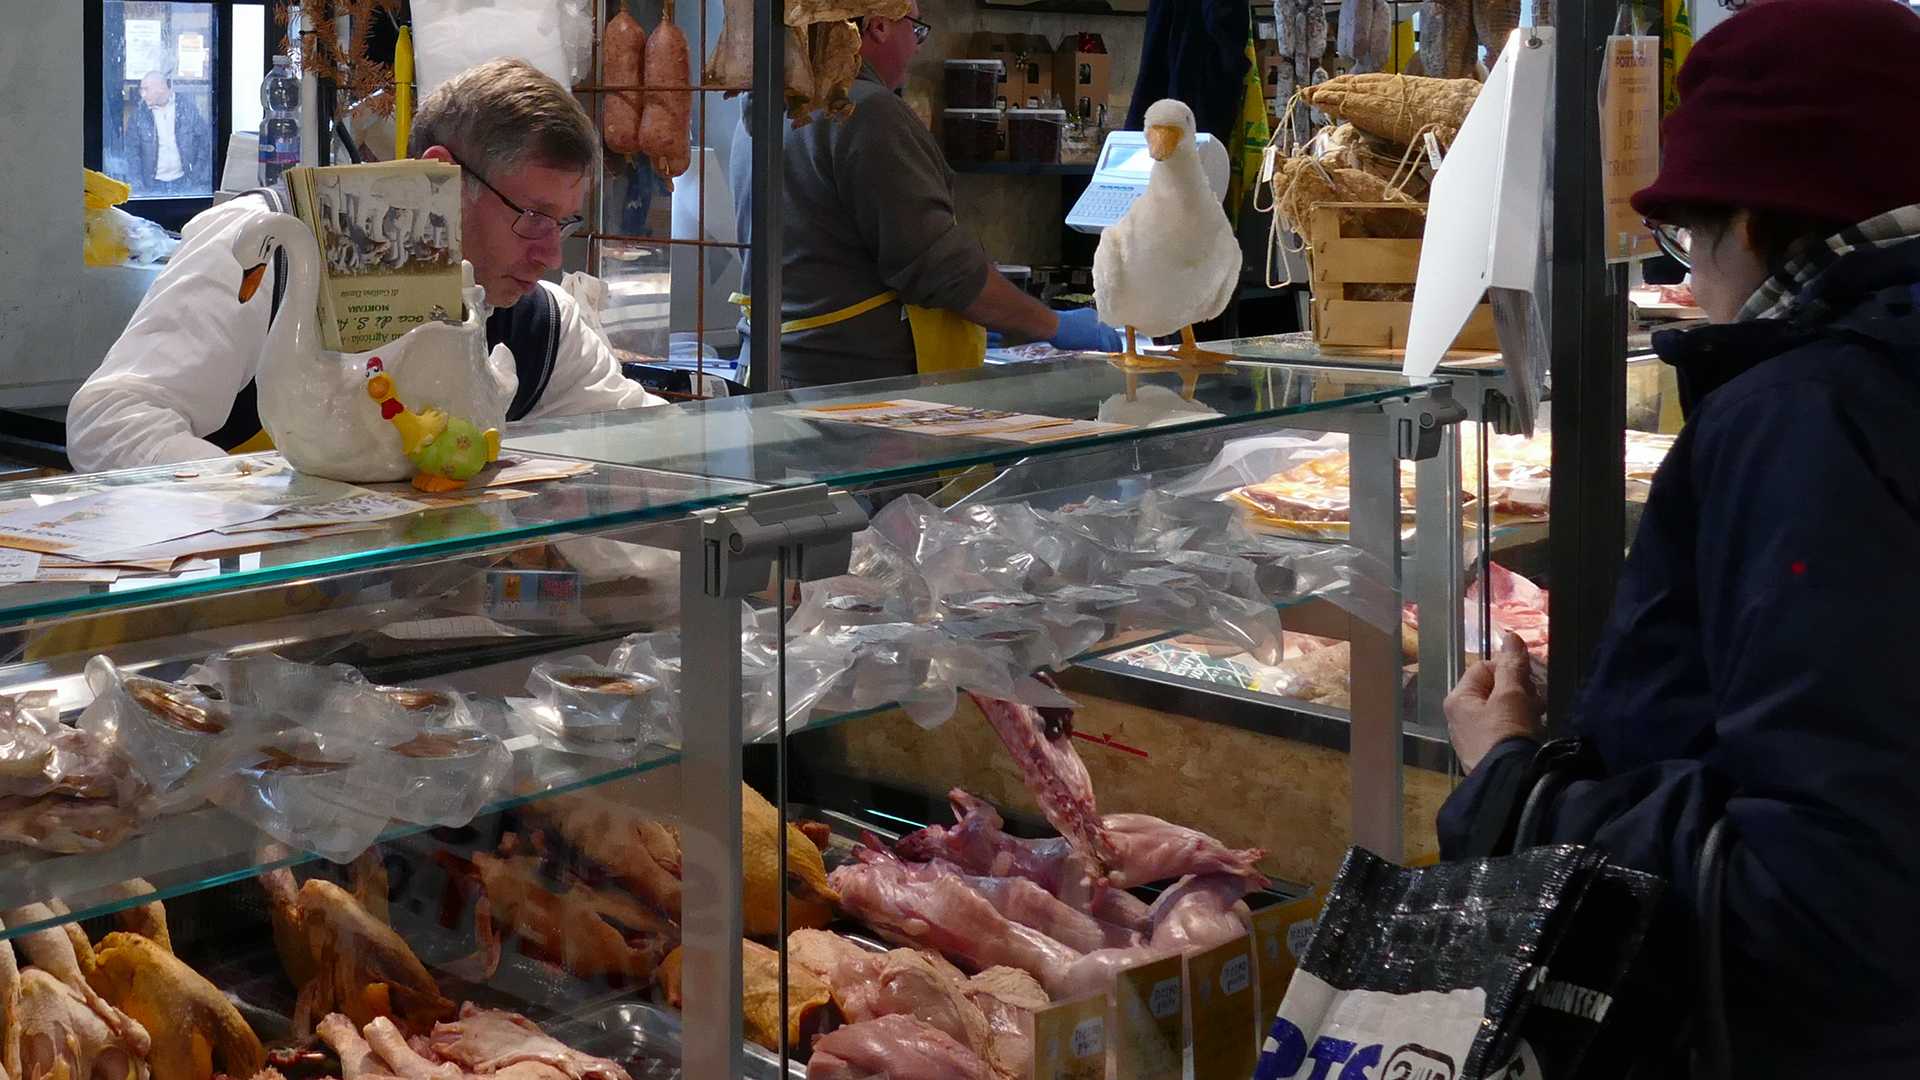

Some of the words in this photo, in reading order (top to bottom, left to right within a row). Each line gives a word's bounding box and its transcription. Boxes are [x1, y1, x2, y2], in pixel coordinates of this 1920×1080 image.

[347, 304, 390, 313] MORTARA
[375, 315, 393, 330] di
[397, 315, 424, 324] oca
[351, 332, 389, 345] Agricola
